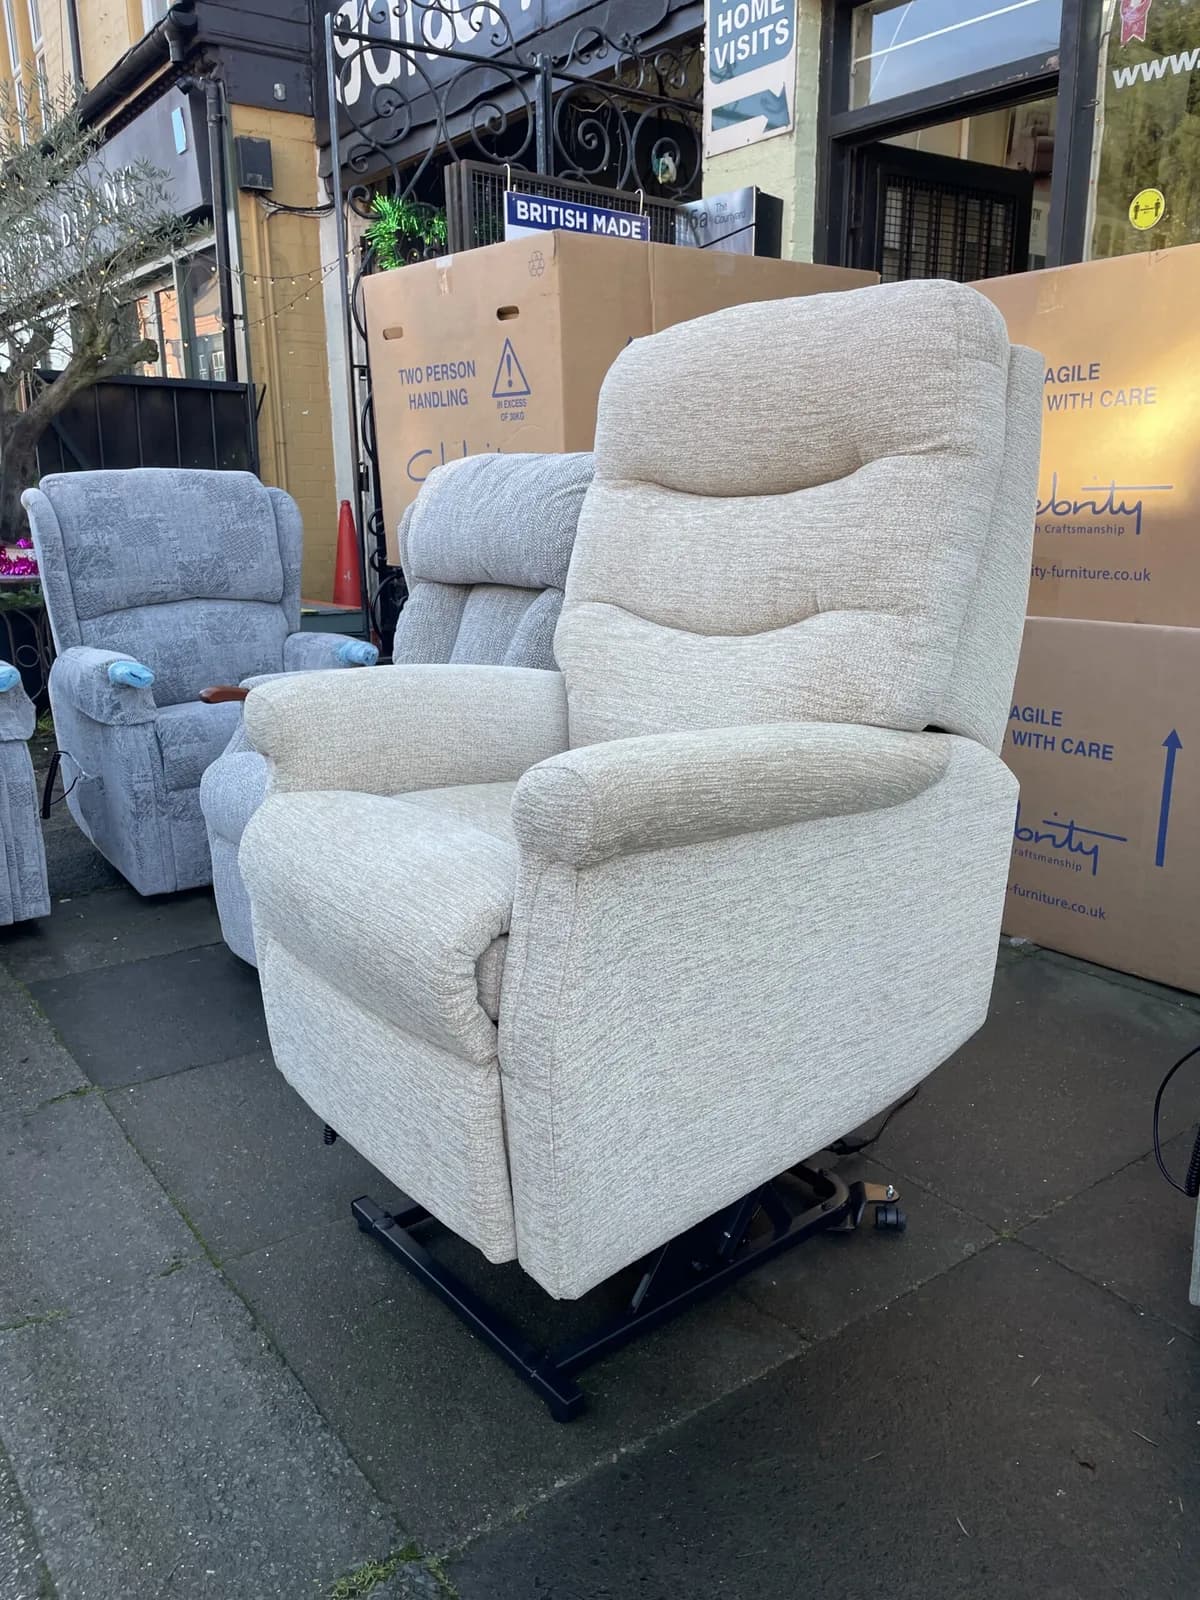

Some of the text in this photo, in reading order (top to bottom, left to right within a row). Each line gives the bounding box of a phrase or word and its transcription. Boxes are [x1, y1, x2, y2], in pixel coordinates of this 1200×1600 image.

[717, 0, 785, 38] HOME
[713, 18, 790, 69] VISITS
[516, 200, 642, 239] BRITISH MADE
[398, 360, 476, 386] TWO PERSON
[1044, 363, 1101, 384] AGILE
[408, 388, 469, 410] HANDLING
[1047, 386, 1157, 411] WITH CARE
[1044, 524, 1125, 536] Craftsmanship
[1031, 564, 1151, 581] ity-furniture.co.uk
[1009, 705, 1064, 727] AGILE
[1012, 730, 1114, 761] WITH CARE
[1005, 883, 1106, 919] -furniture.co.uk
